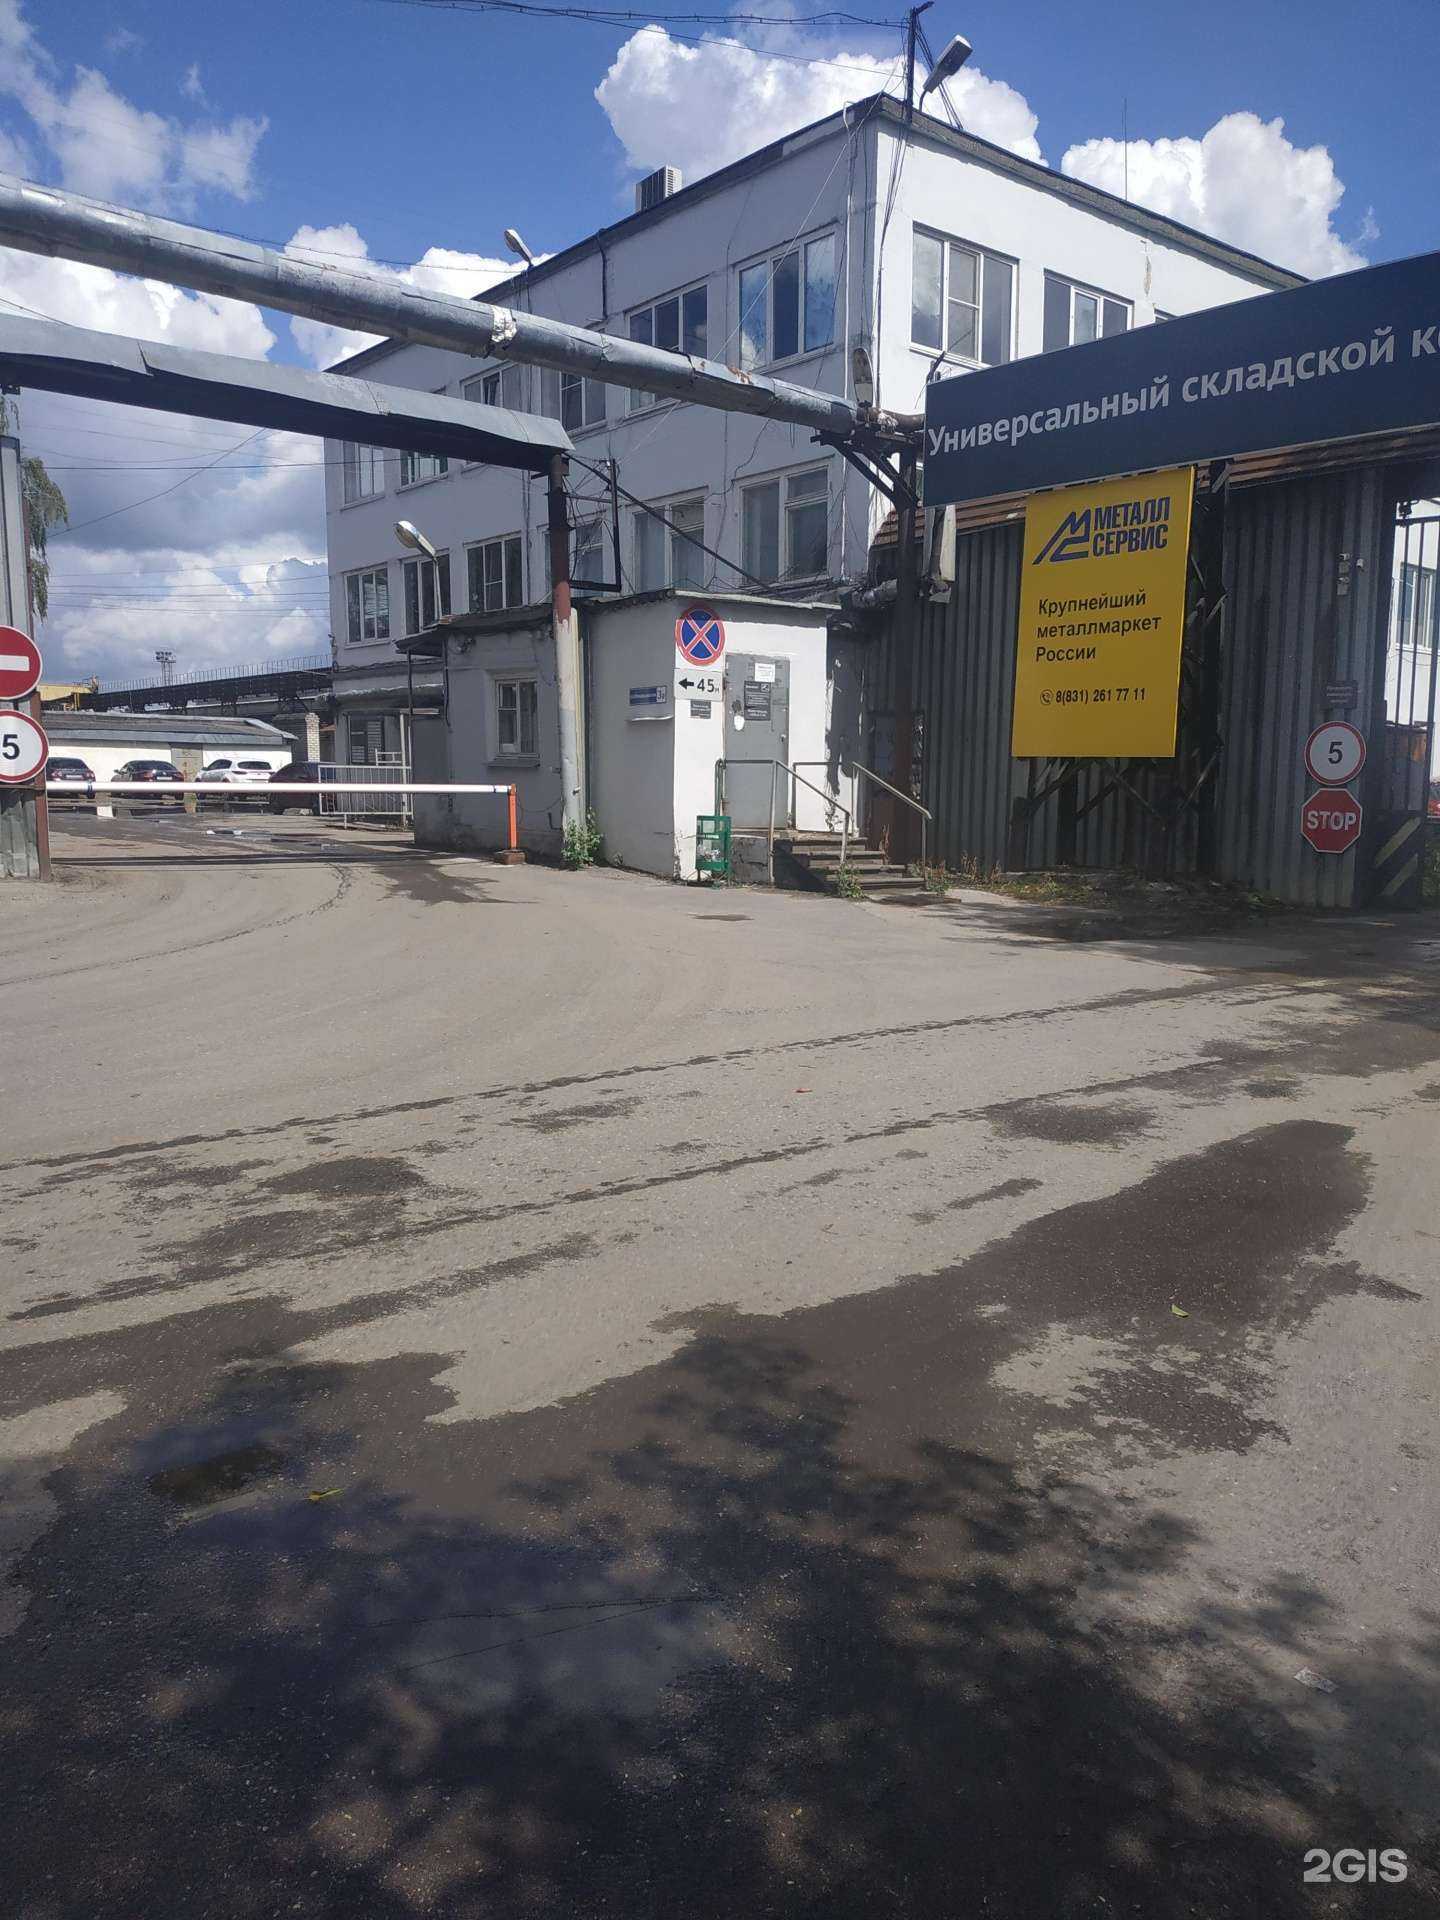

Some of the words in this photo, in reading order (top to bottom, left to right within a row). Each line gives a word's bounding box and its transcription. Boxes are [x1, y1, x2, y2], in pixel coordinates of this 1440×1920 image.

[927, 374, 1170, 456] Универсальный
[1181, 325, 1395, 402] складской
[1411, 325, 1440, 358] к
[1093, 496, 1171, 531] МЕТАЛЛ
[1092, 523, 1169, 557] СЕРВИС
[1038, 587, 1146, 618] Крупнейший
[1036, 616, 1162, 639] металлмаркет
[1035, 646, 1097, 662] России
[1055, 689, 1089, 706] 8(831)
[1093, 688, 1113, 702] 261
[1116, 687, 1130, 701] 77
[1133, 687, 1146, 701] 11
[2, 733, 20, 760] 5
[1327, 741, 1343, 765] 5
[1306, 810, 1357, 831] STOP
